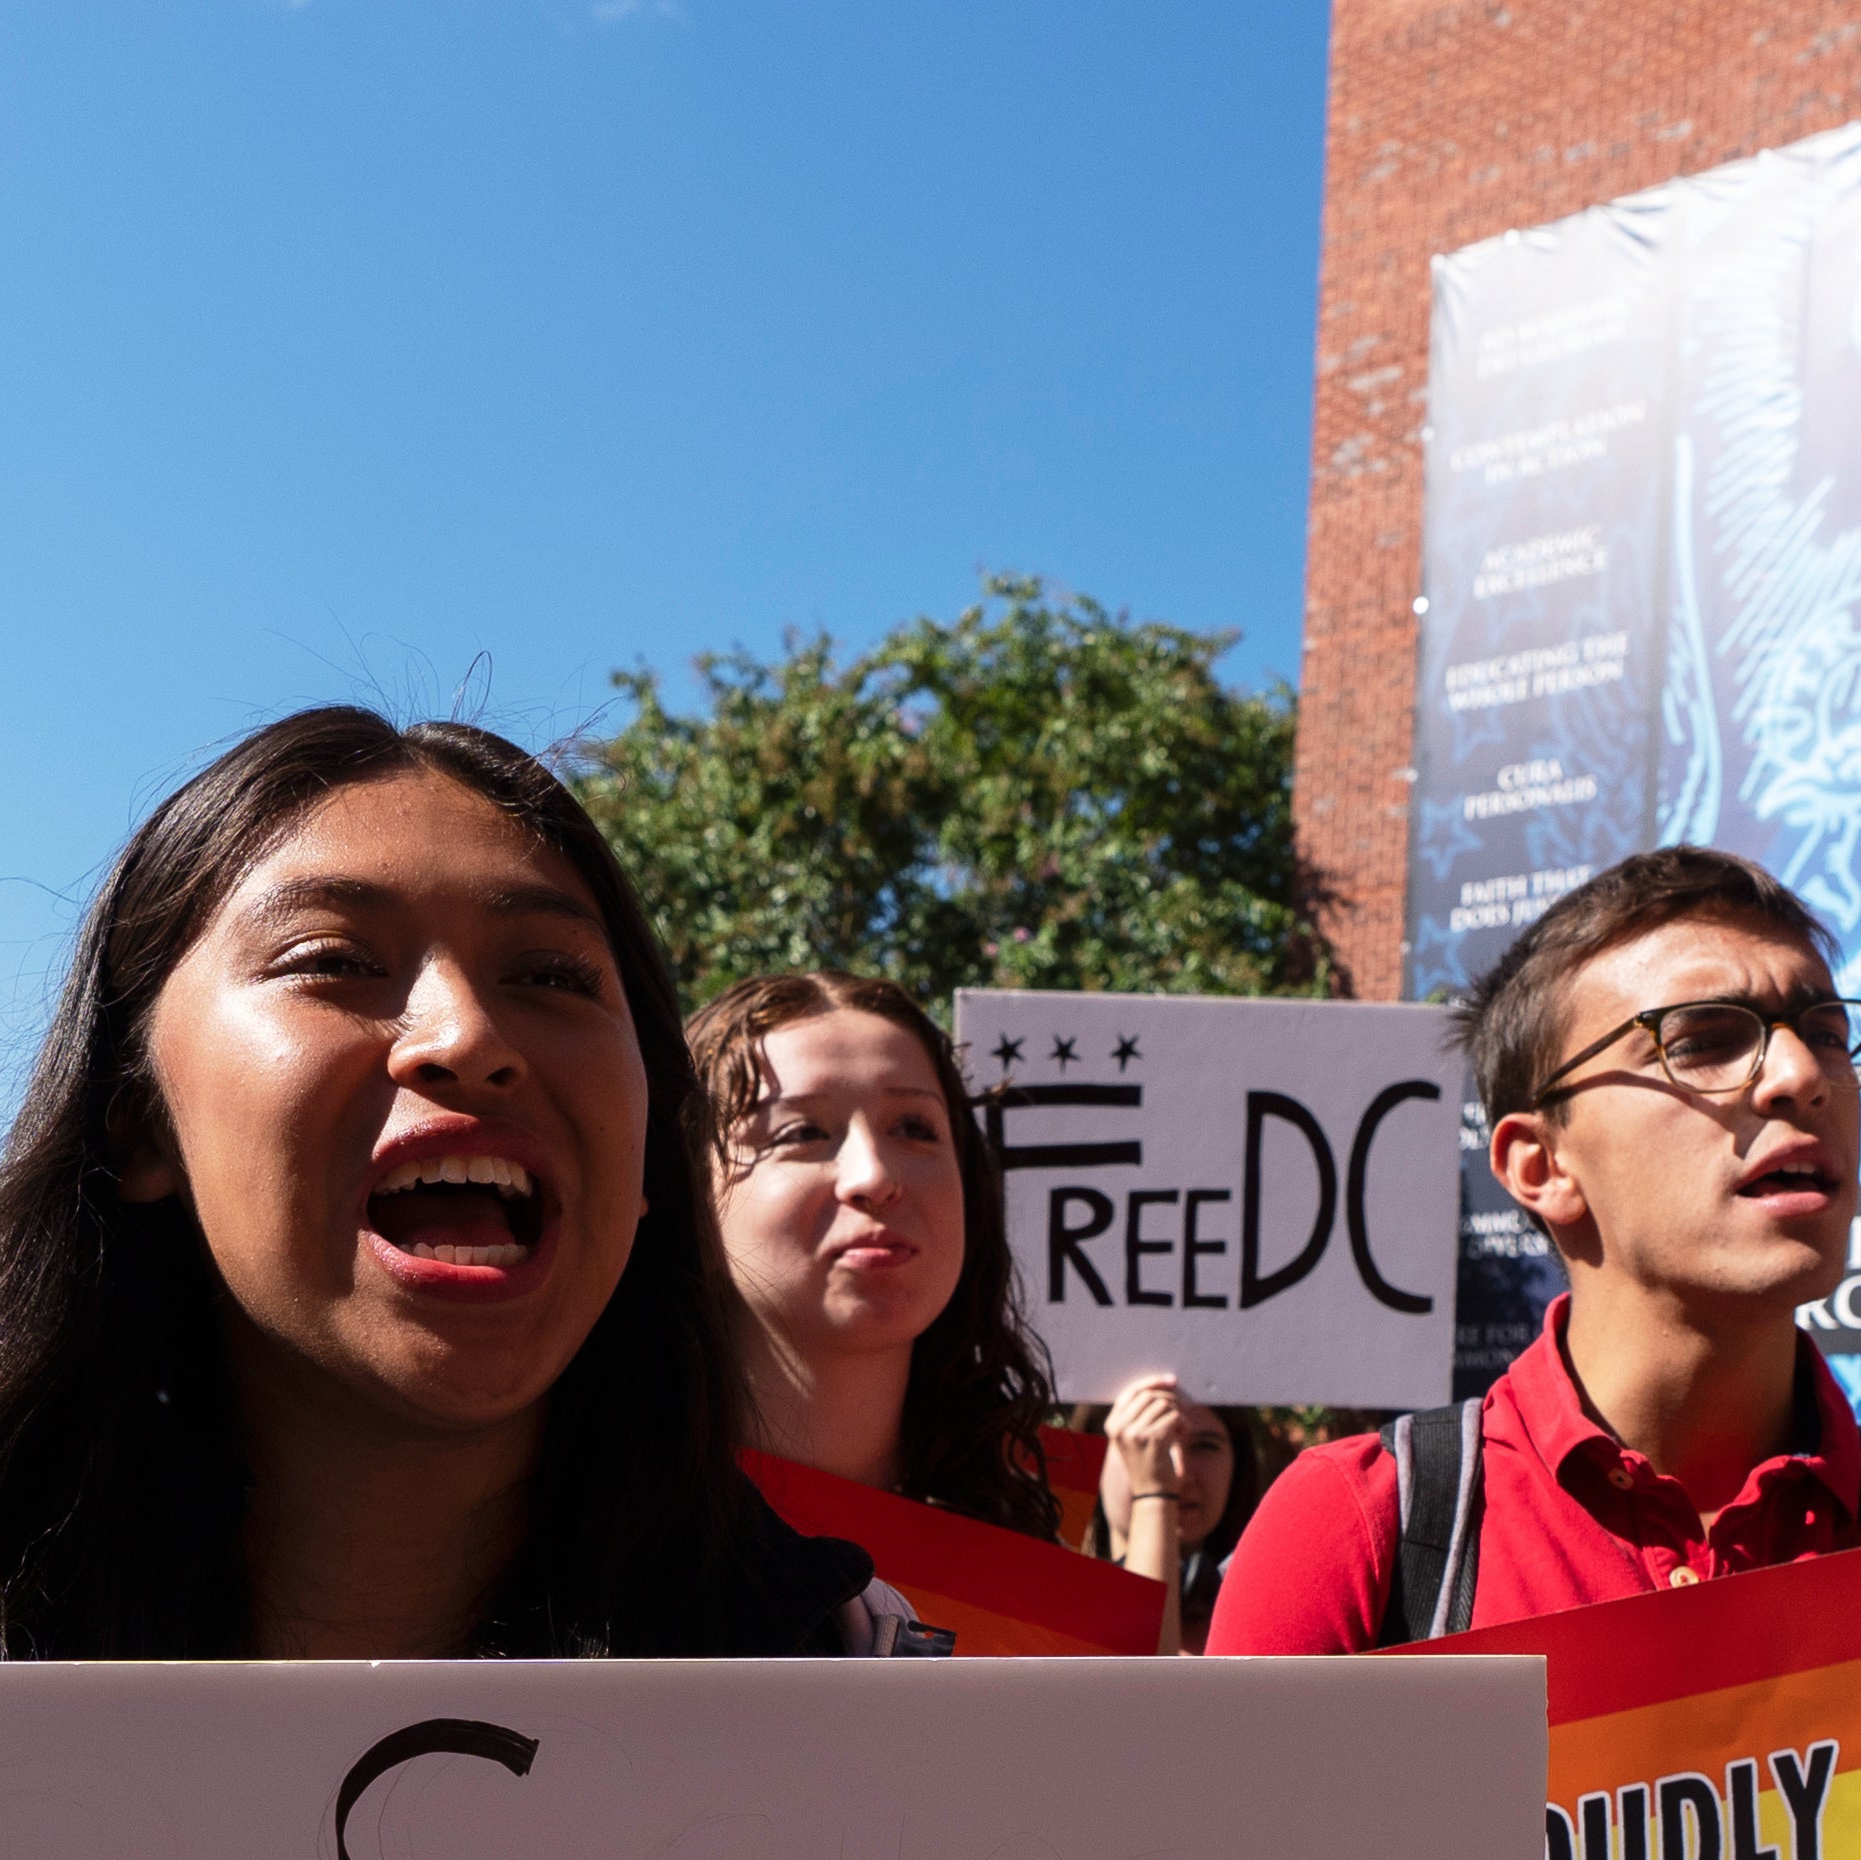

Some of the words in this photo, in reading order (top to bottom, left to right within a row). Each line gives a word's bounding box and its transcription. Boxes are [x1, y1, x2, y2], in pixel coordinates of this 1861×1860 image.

[1496, 757, 1564, 792] CURA
[1463, 775, 1598, 822] PERSONALIS
[1460, 873, 1528, 906] FAITH
[1449, 902, 1511, 933] DOES
[1240, 1080, 1441, 1314] DC
